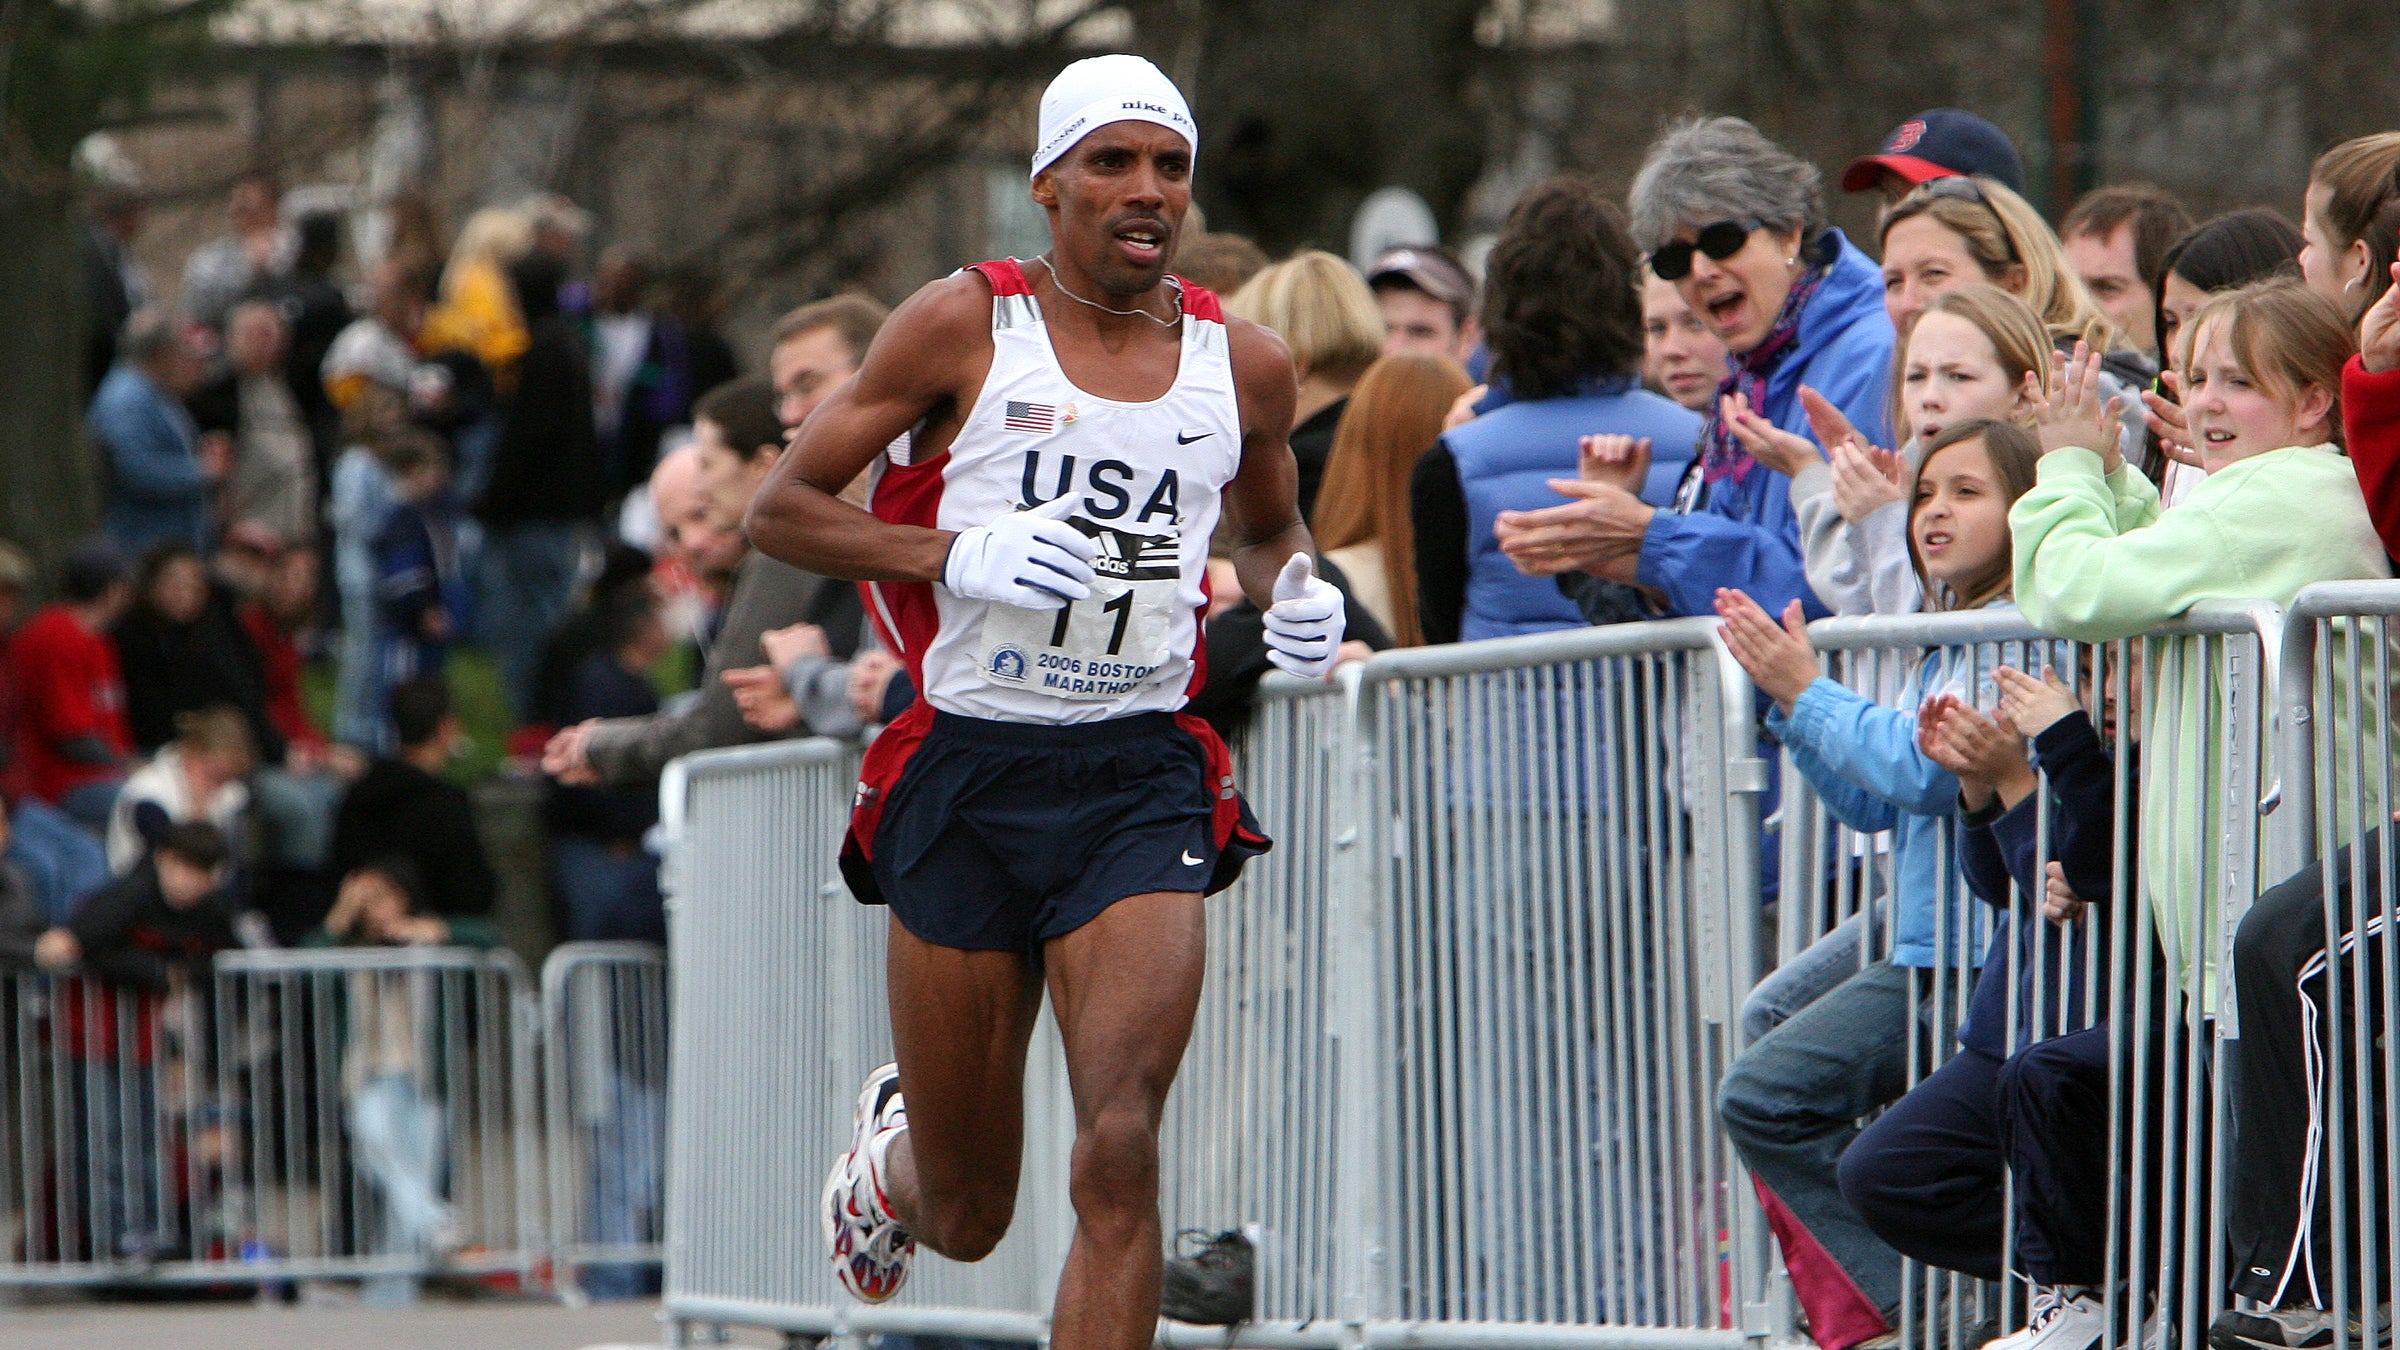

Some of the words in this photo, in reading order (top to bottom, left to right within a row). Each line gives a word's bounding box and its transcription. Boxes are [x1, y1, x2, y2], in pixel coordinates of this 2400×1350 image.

[1121, 100, 1168, 114] nike
[1021, 450, 1178, 526] USA
[1049, 588, 1135, 656] 11
[1037, 653, 1082, 674] 2006
